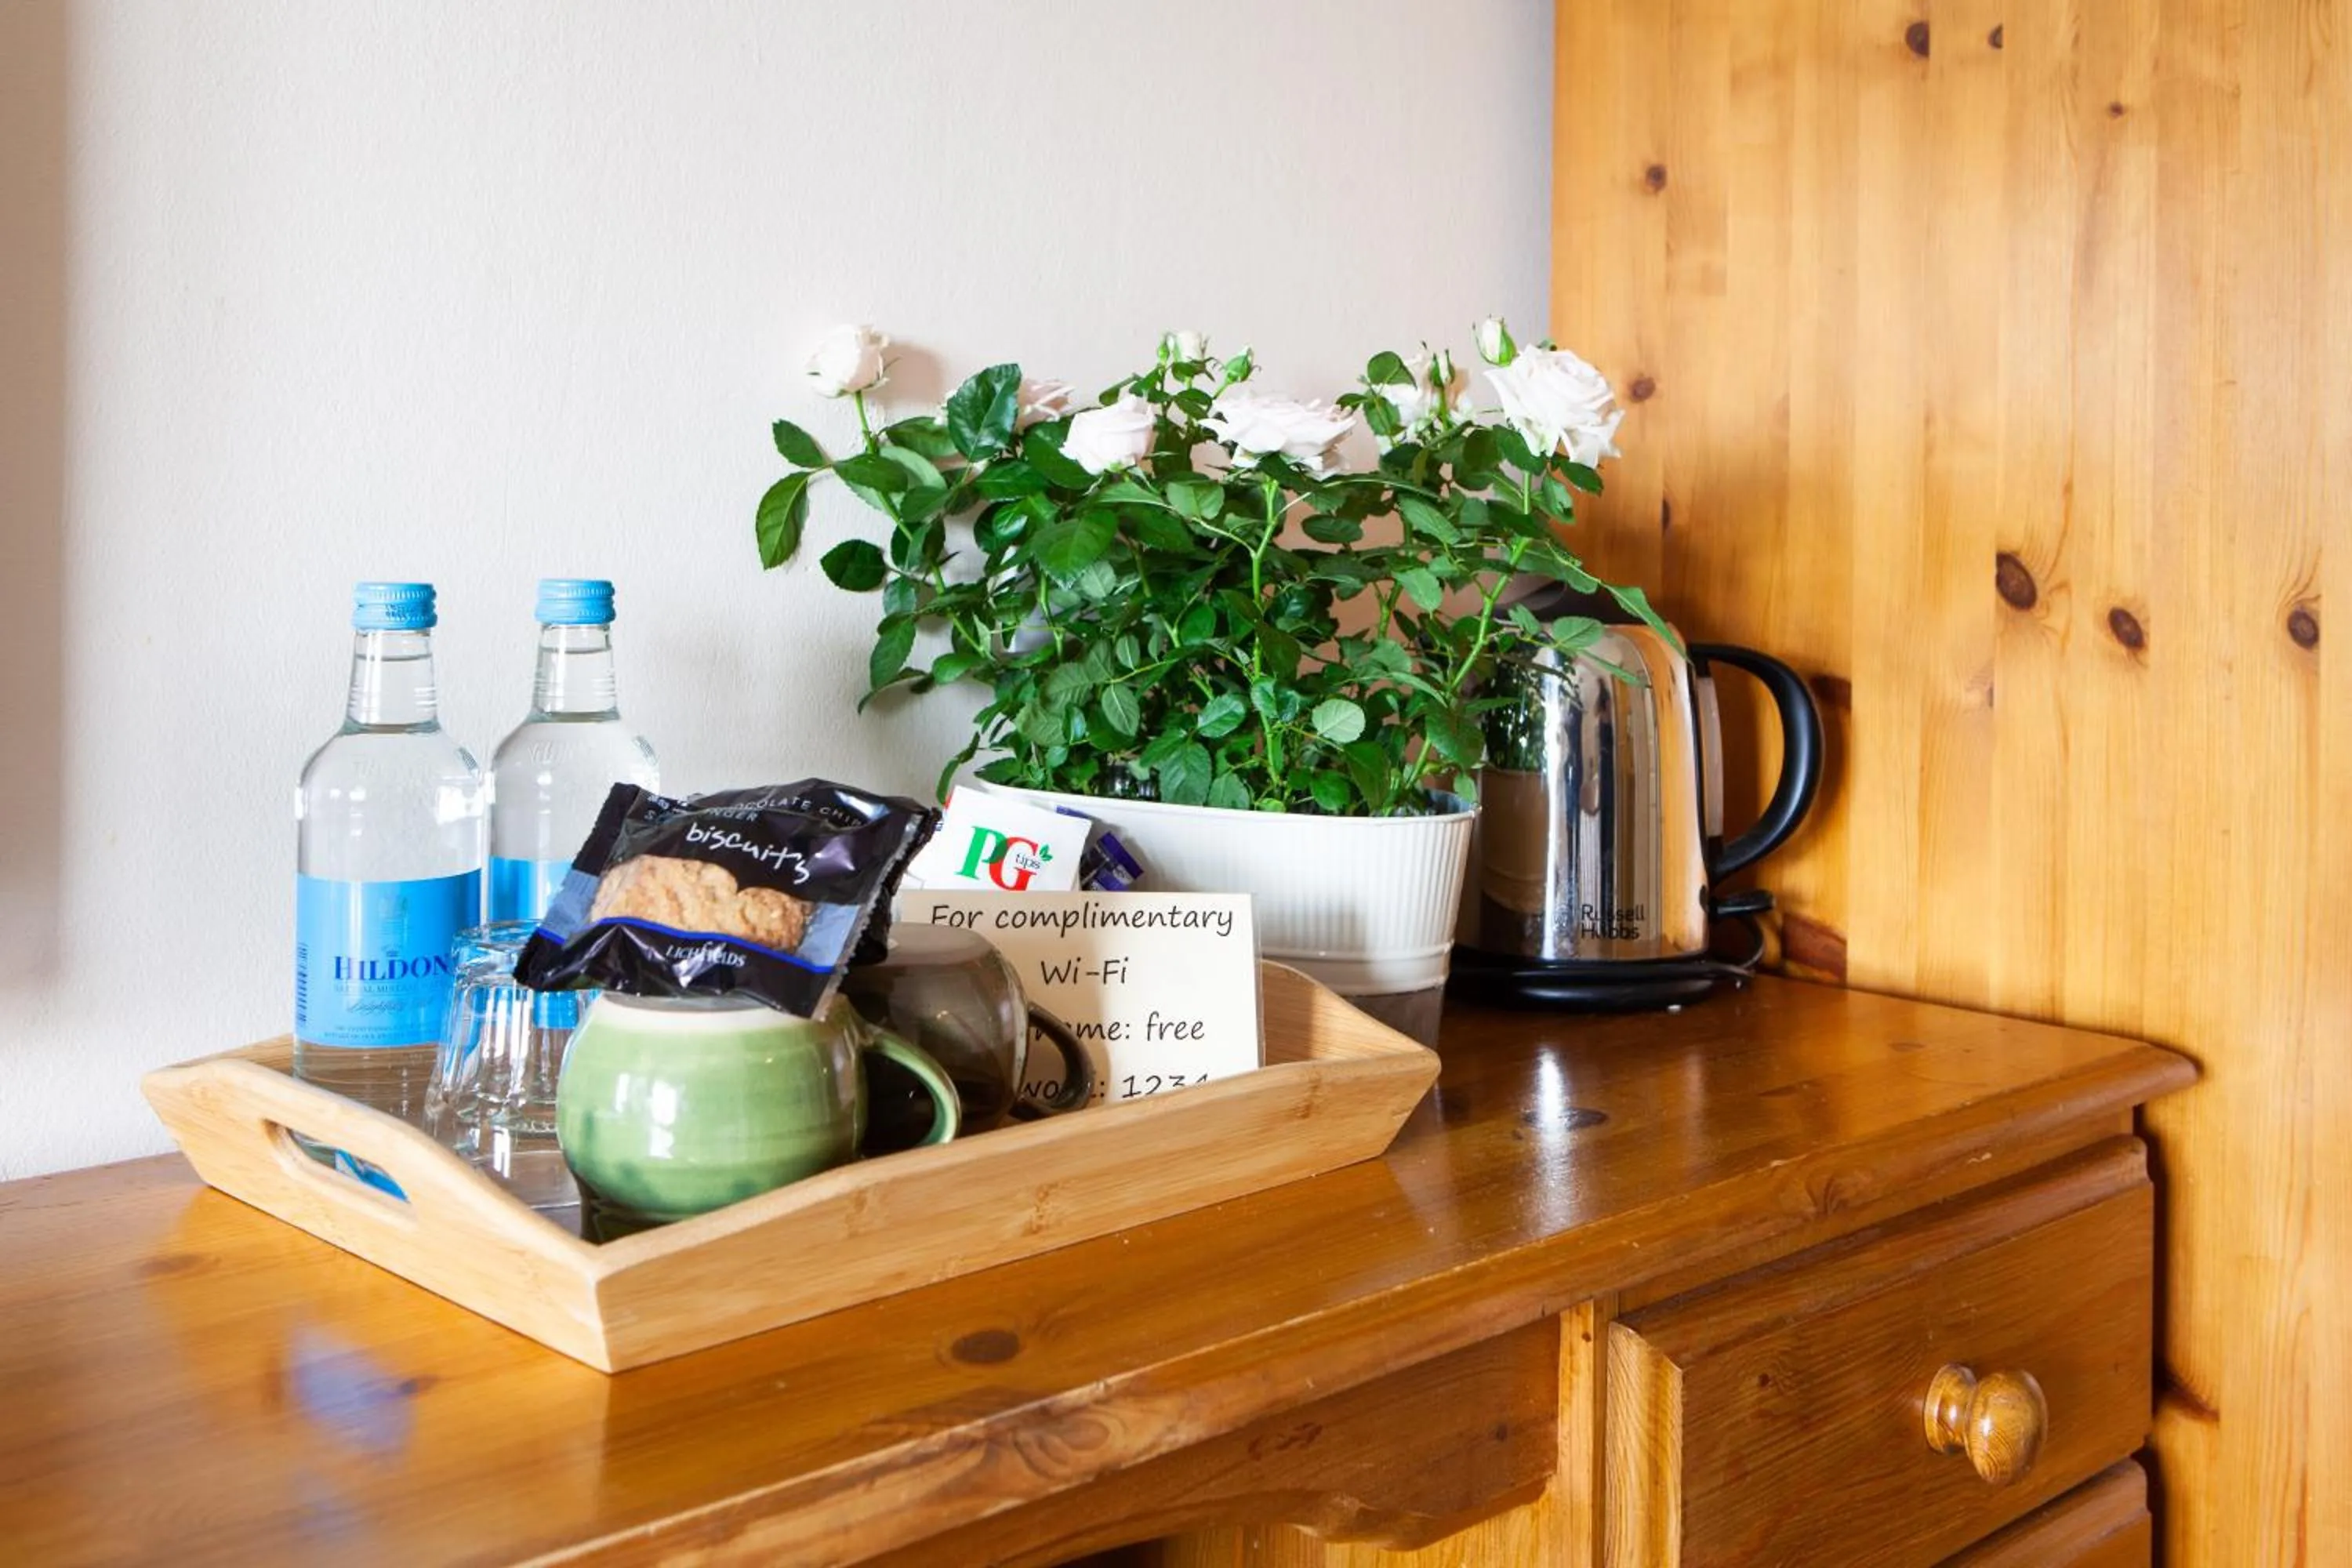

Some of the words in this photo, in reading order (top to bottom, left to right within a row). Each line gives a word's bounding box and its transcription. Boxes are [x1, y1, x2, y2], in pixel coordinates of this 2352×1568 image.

[686, 822, 810, 885] biscuits
[954, 826, 1038, 891] PG
[1015, 851, 1041, 869] tips
[931, 905, 983, 928] For
[995, 902, 1233, 937] complimentary
[334, 954, 454, 981] HILDON
[1040, 956, 1130, 985] Wi-Fi
[1146, 1011, 1205, 1041] free
